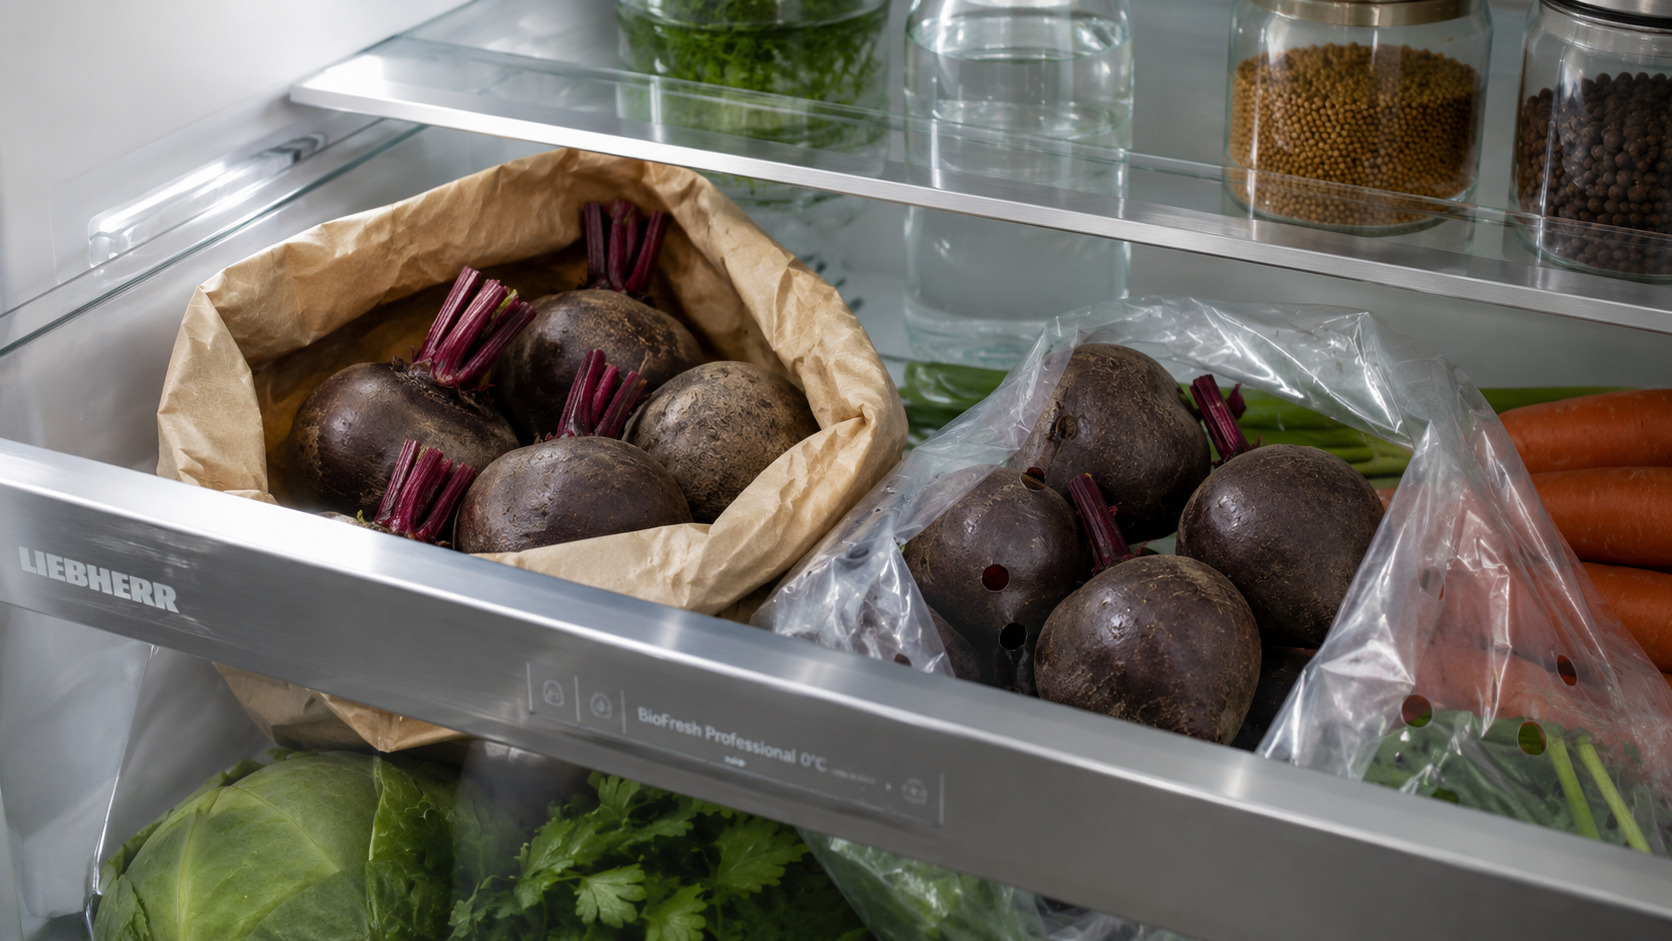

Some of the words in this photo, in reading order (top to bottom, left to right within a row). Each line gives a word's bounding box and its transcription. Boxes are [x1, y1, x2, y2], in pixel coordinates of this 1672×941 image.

[18, 546, 179, 613] LIEBHERR
[638, 706, 701, 737] BioFresh
[705, 725, 796, 764] Professional
[800, 751, 827, 772] 0°C
